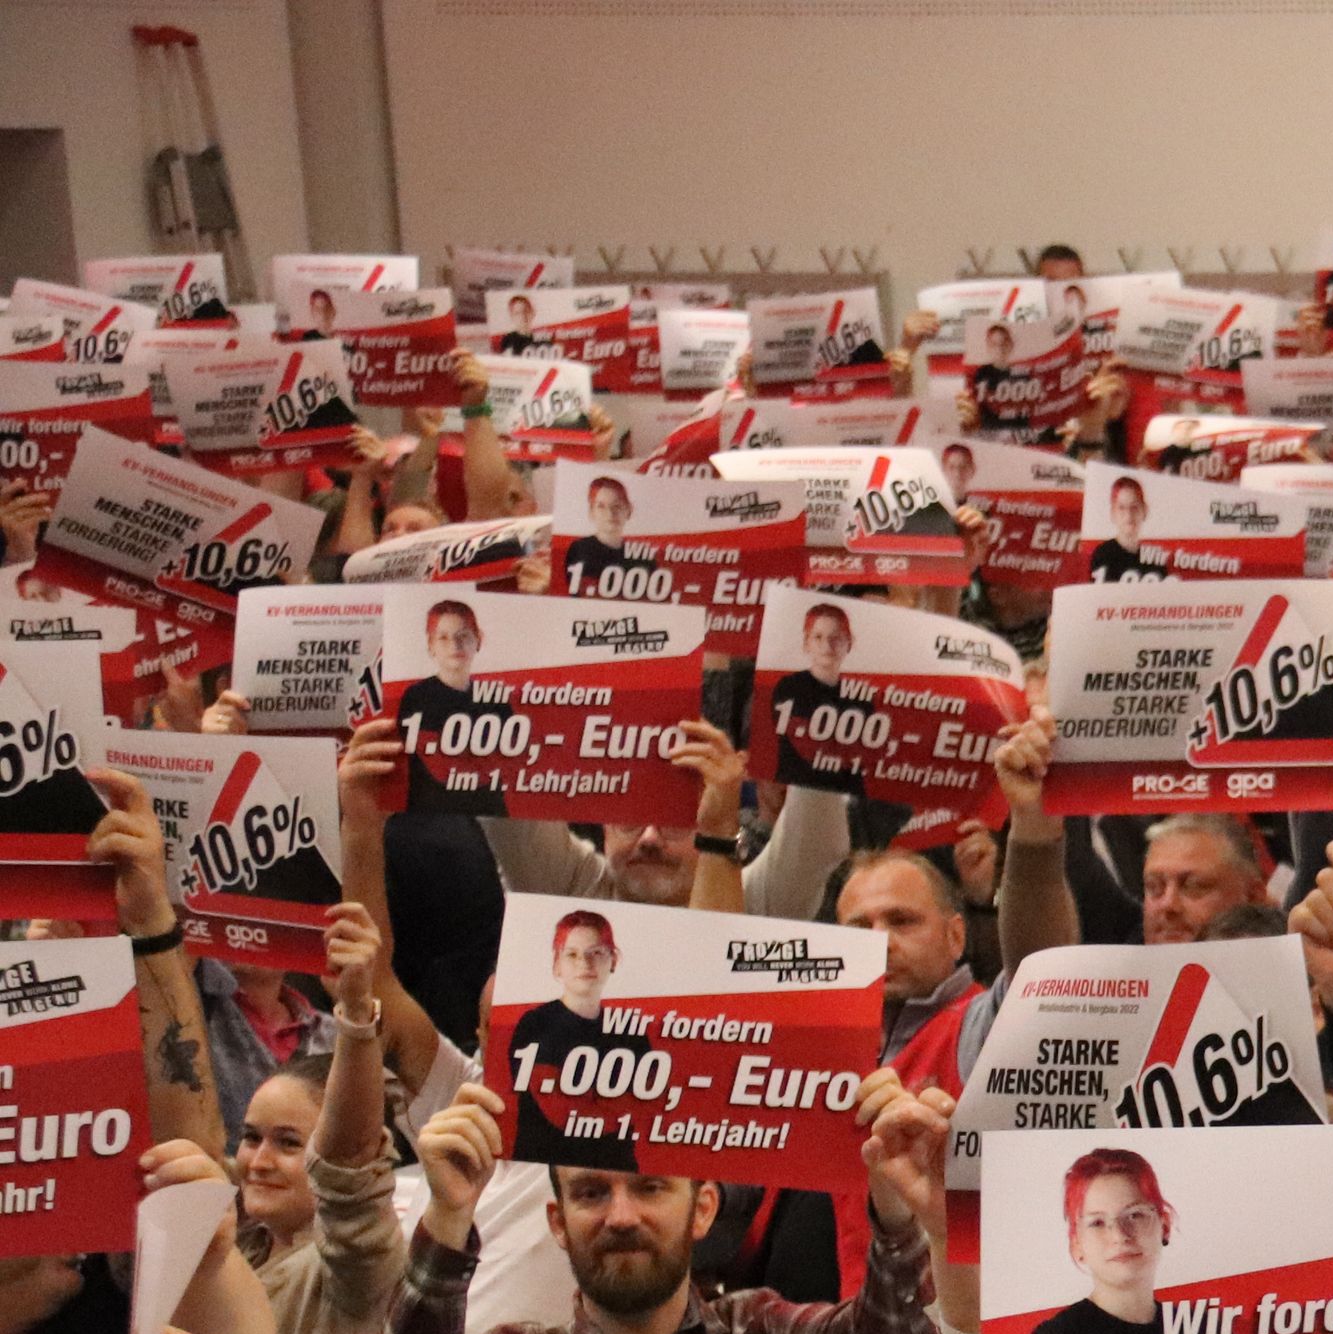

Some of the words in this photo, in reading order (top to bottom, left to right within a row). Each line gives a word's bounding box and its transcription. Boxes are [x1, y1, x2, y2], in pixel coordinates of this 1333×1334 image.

[394, 351, 450, 375] Euro
[583, 340, 626, 361] Euro
[95, 498, 186, 545] MENSCHEN,
[139, 498, 204, 532] STARKE
[57, 516, 158, 564] FORDERUNG!
[109, 523, 171, 555] STARKE
[624, 540, 658, 560] Wir
[664, 543, 740, 564] fordern
[161, 538, 293, 586] +10,6%
[1139, 543, 1170, 566] Wir
[1173, 548, 1241, 573] fordern
[567, 562, 700, 605] 1.000,-
[1096, 605, 1244, 621] KV-VERHANDLUNGEN
[297, 640, 361, 657] STARKE
[1136, 649, 1214, 668] STARKE
[256, 659, 354, 677] MENSCHEN,
[280, 678, 345, 694] STARKE
[472, 680, 514, 704] Wir
[521, 681, 613, 706] fordern
[840, 678, 878, 702] Wir
[883, 684, 966, 715] fordern
[1083, 672, 1201, 694] MENSCHEN,
[1112, 696, 1189, 715] STARKE
[401, 712, 565, 766] 1.000,-
[579, 715, 687, 759] Euro
[774, 700, 921, 756] 1.000,-
[1056, 718, 1177, 738] FORDERUNG!
[446, 768, 478, 791] im
[489, 769, 507, 792] 1.
[516, 769, 630, 797] Lehrjahr!
[812, 751, 840, 772] im
[874, 760, 979, 790] Lehrjahr!
[1132, 775, 1209, 793] PRO-GE
[1227, 773, 1276, 797] gpa
[181, 796, 315, 891] +10,6%
[225, 922, 269, 951] gpa
[1021, 979, 1149, 999] KV-VERHANDLUNGEN
[601, 1006, 654, 1037] Wir
[661, 1010, 774, 1044] fordern
[1037, 1038, 1120, 1065] STARKE
[511, 1042, 712, 1111] 1.000,-
[729, 1055, 860, 1112] Euro
[986, 1068, 1109, 1102] MENSCHEN,
[1015, 1102, 1096, 1129] STARKE
[564, 1110, 604, 1139] im
[616, 1115, 640, 1142] 1.
[648, 1115, 791, 1153] Lehrjahr!
